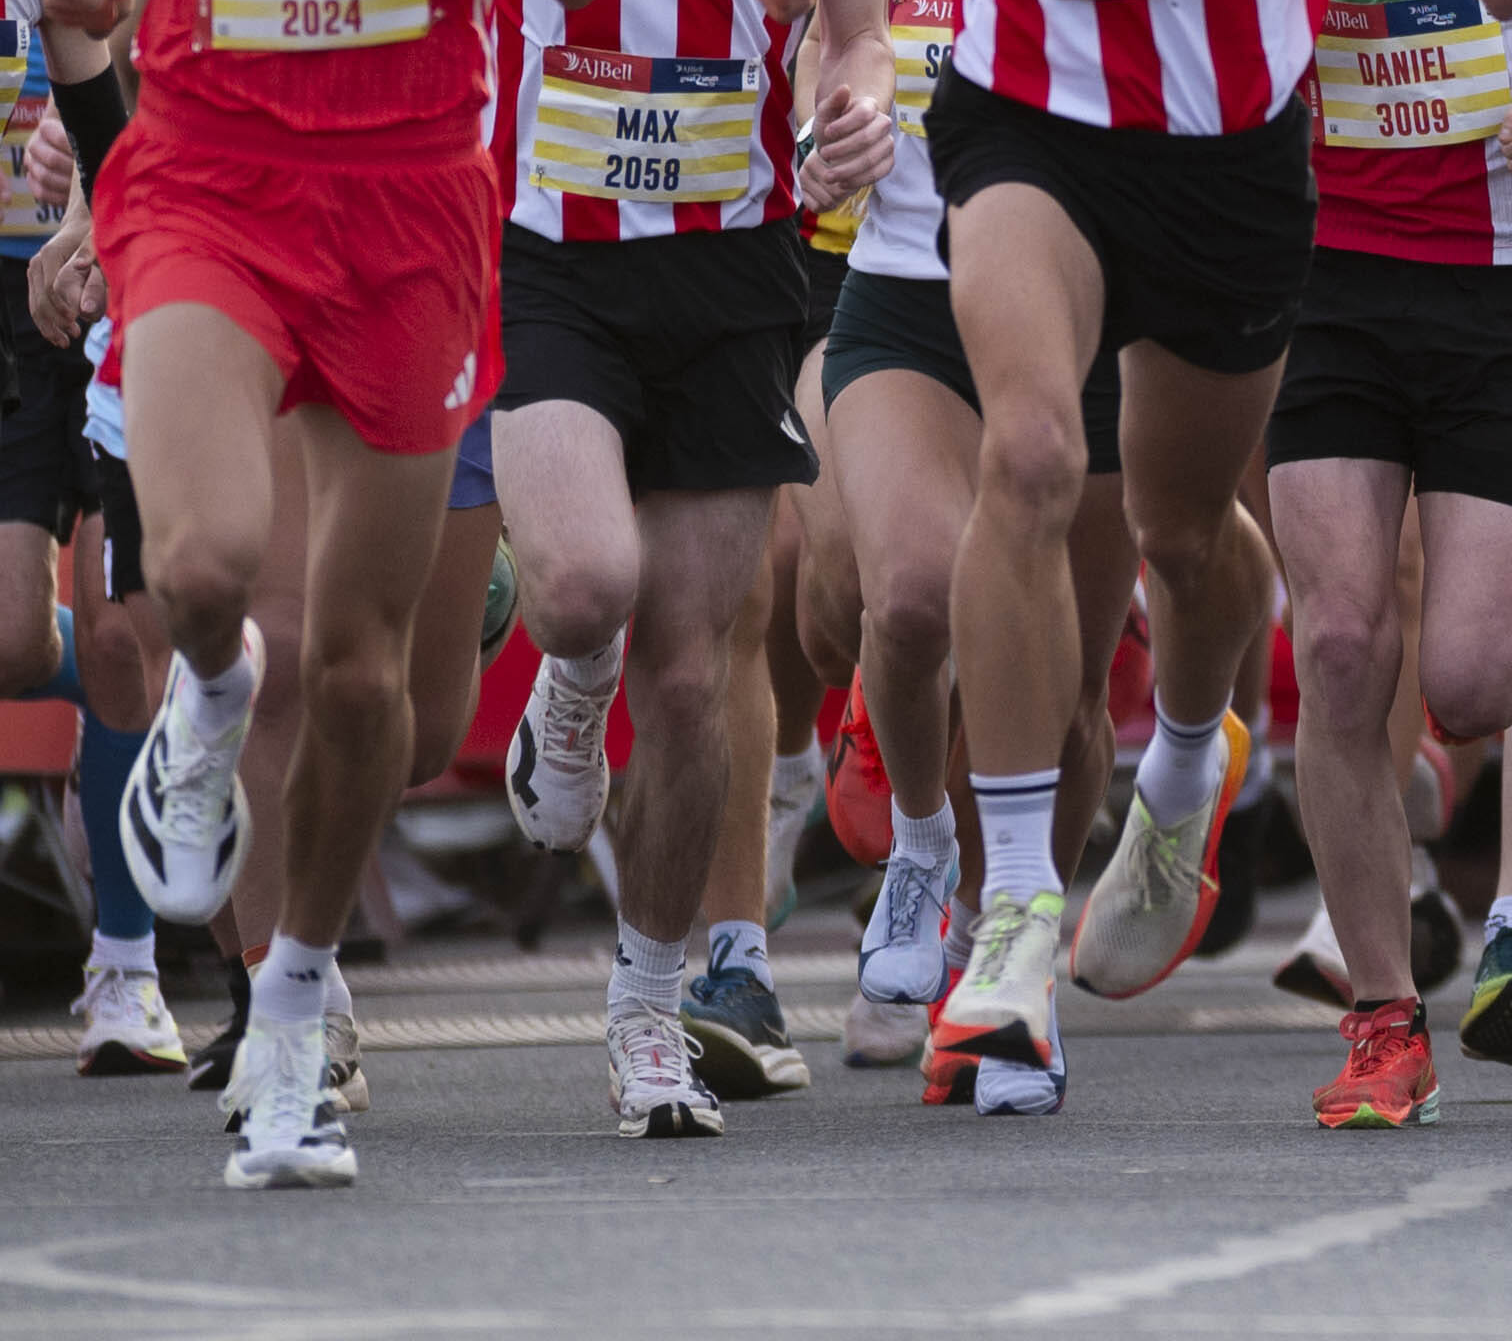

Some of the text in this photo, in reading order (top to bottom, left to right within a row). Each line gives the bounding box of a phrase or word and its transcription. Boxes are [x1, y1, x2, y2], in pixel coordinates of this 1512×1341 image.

[1323, 9, 1369, 31] AJBell
[577, 57, 633, 82] AJBell
[1357, 46, 1456, 87] DANIEL
[616, 106, 680, 143] MAX
[1376, 98, 1450, 137] 3009
[604, 154, 681, 192] 2058
